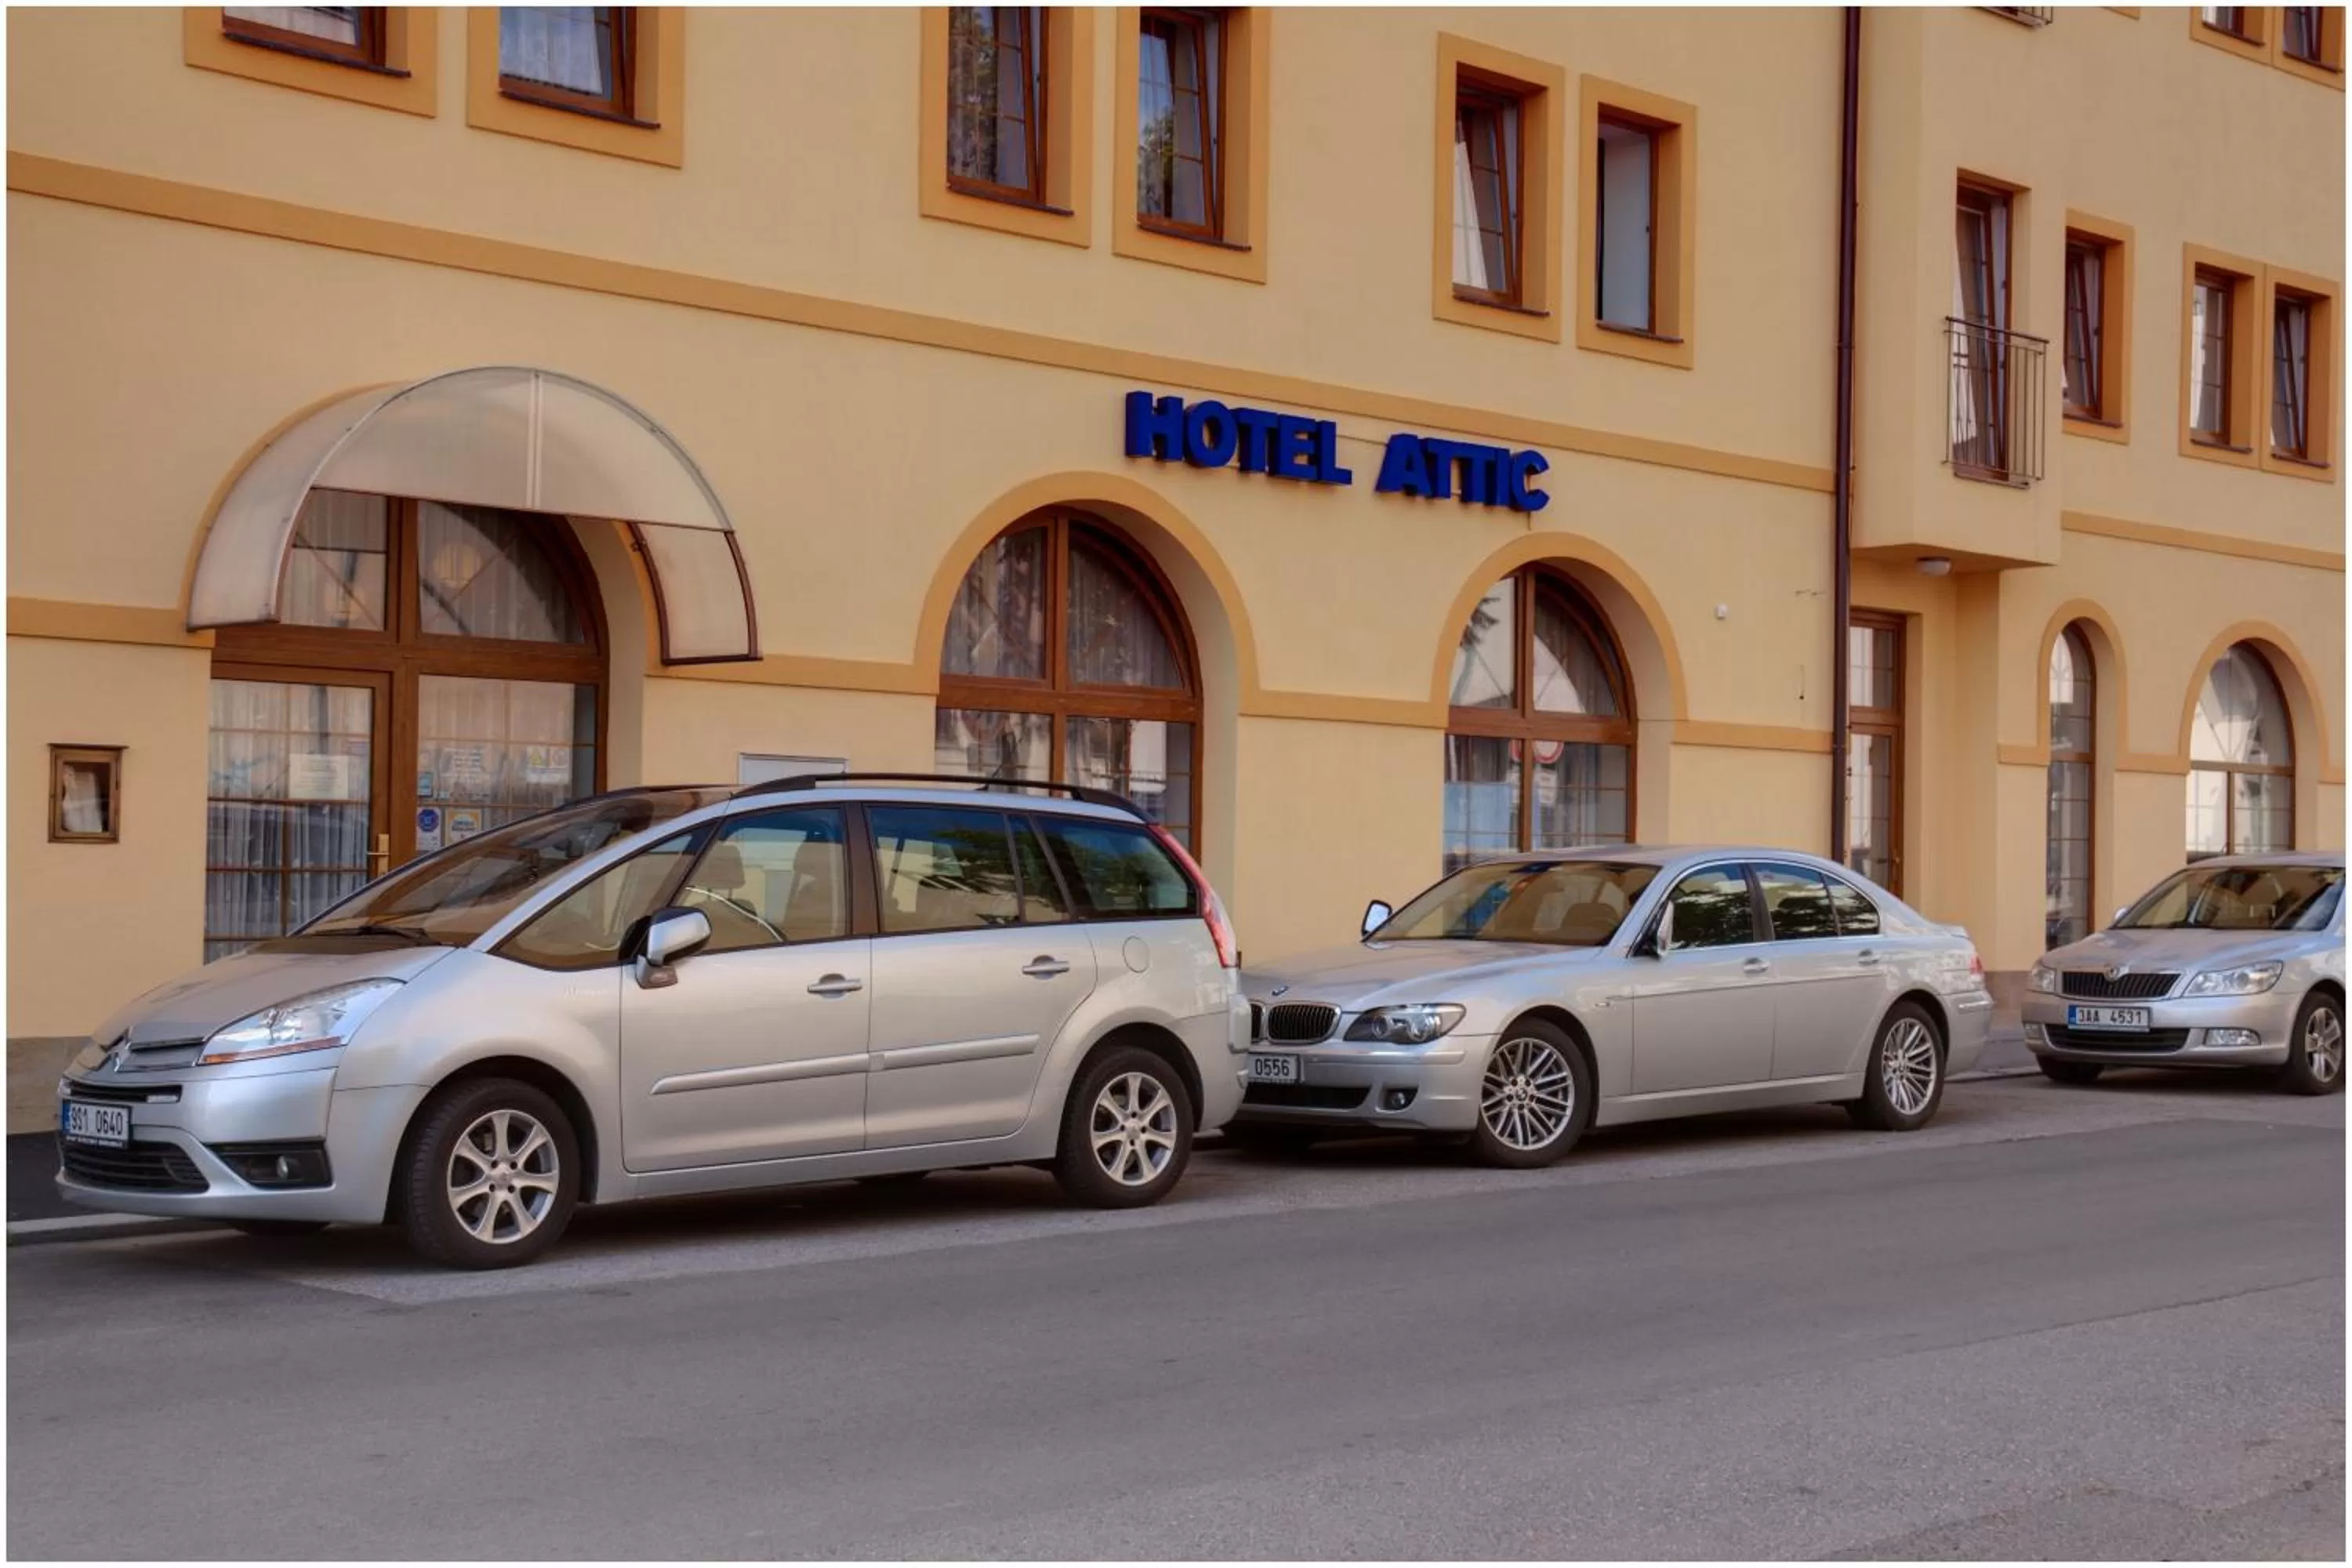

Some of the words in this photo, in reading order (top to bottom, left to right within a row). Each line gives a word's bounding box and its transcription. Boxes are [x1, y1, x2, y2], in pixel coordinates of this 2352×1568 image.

[1125, 390, 1352, 484] HOTEL
[1375, 433, 1550, 511] ATTIC
[2110, 1010, 2142, 1024] 4531
[1255, 1058, 1290, 1076] 0556
[71, 1106, 89, 1131] 9S1
[96, 1109, 123, 1136] 0640
